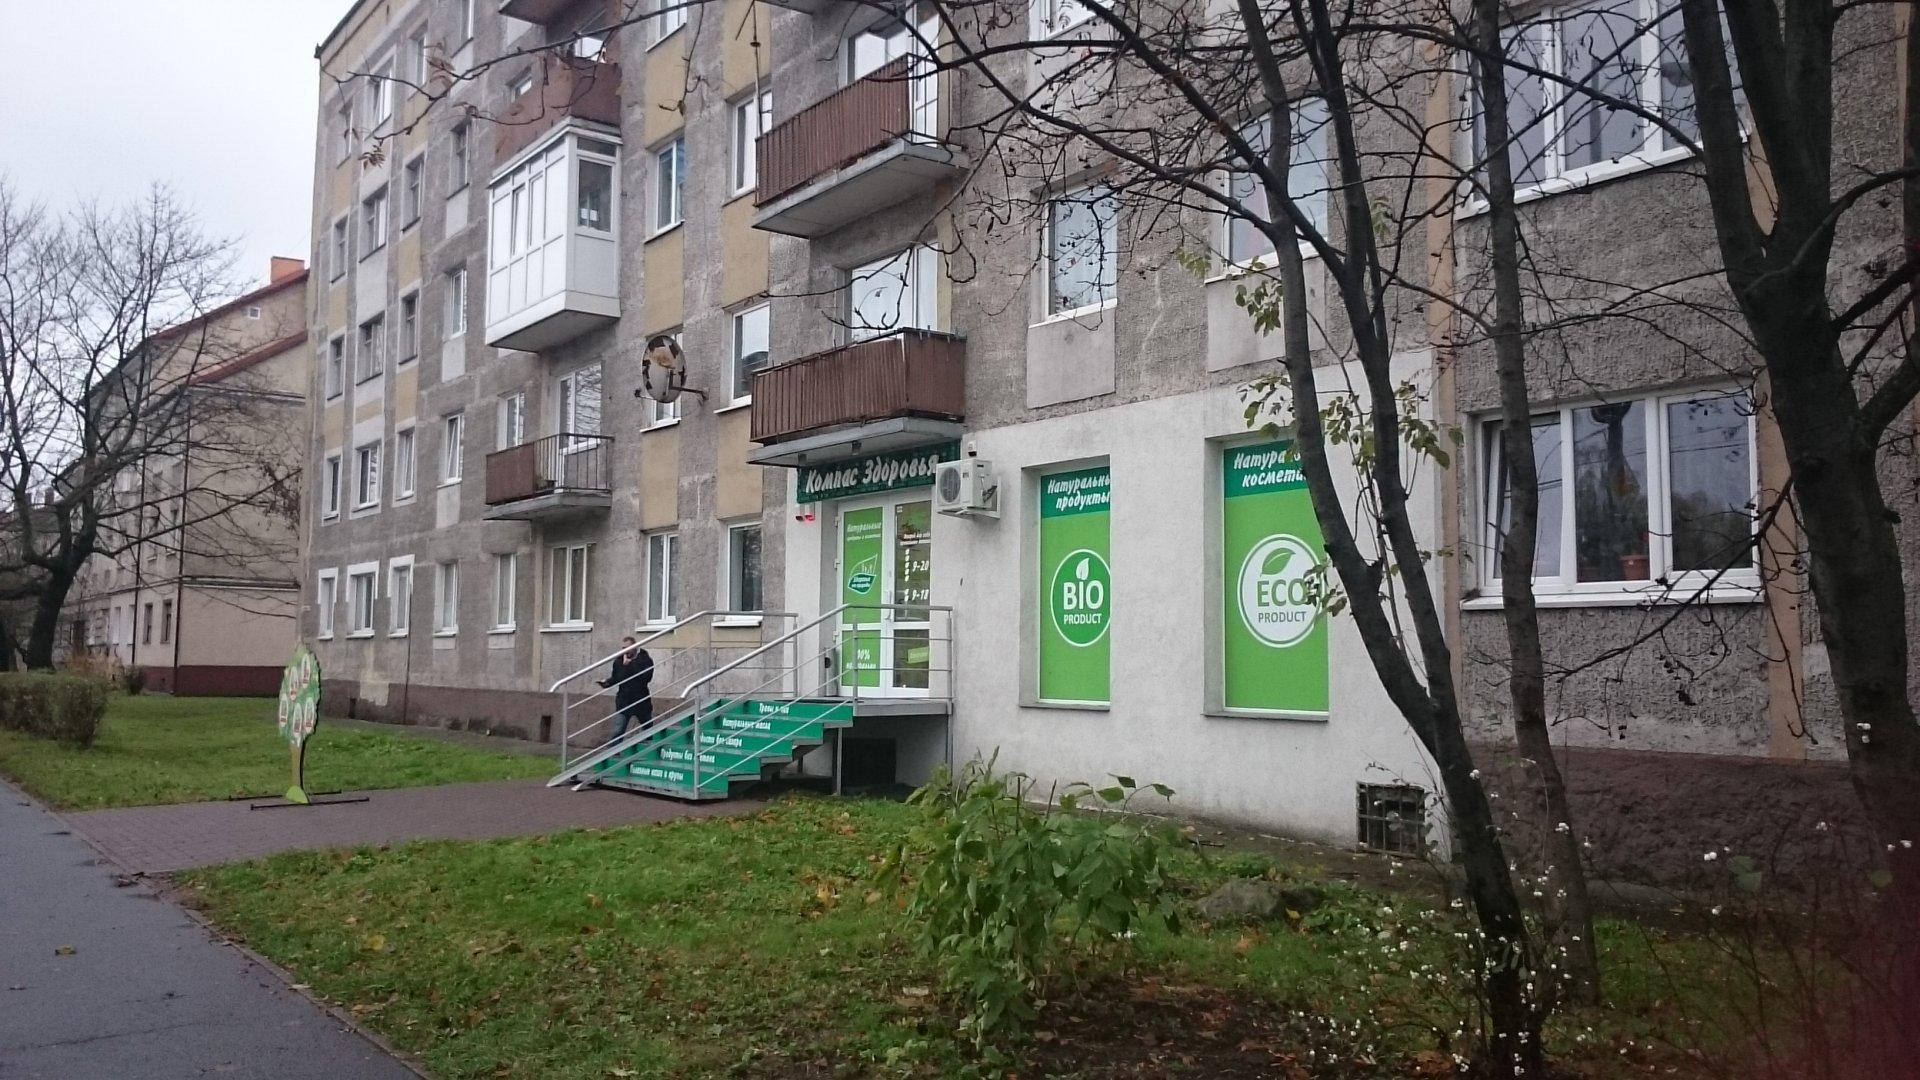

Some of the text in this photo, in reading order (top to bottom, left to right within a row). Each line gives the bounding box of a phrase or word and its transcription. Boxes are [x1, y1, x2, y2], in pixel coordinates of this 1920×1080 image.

[1233, 449, 1301, 471] Натураь
[805, 454, 940, 494] Компас Здоровья
[1241, 469, 1306, 488] космети
[1055, 490, 1110, 512] продукты
[912, 560, 930, 572] 9-20
[1063, 580, 1104, 610] BIO
[1257, 578, 1308, 607] ECO
[1063, 613, 1102, 625] PRODUCT
[1258, 611, 1307, 623] PRODUCT
[660, 748, 684, 760] Продукты
[684, 750, 693, 761] без
